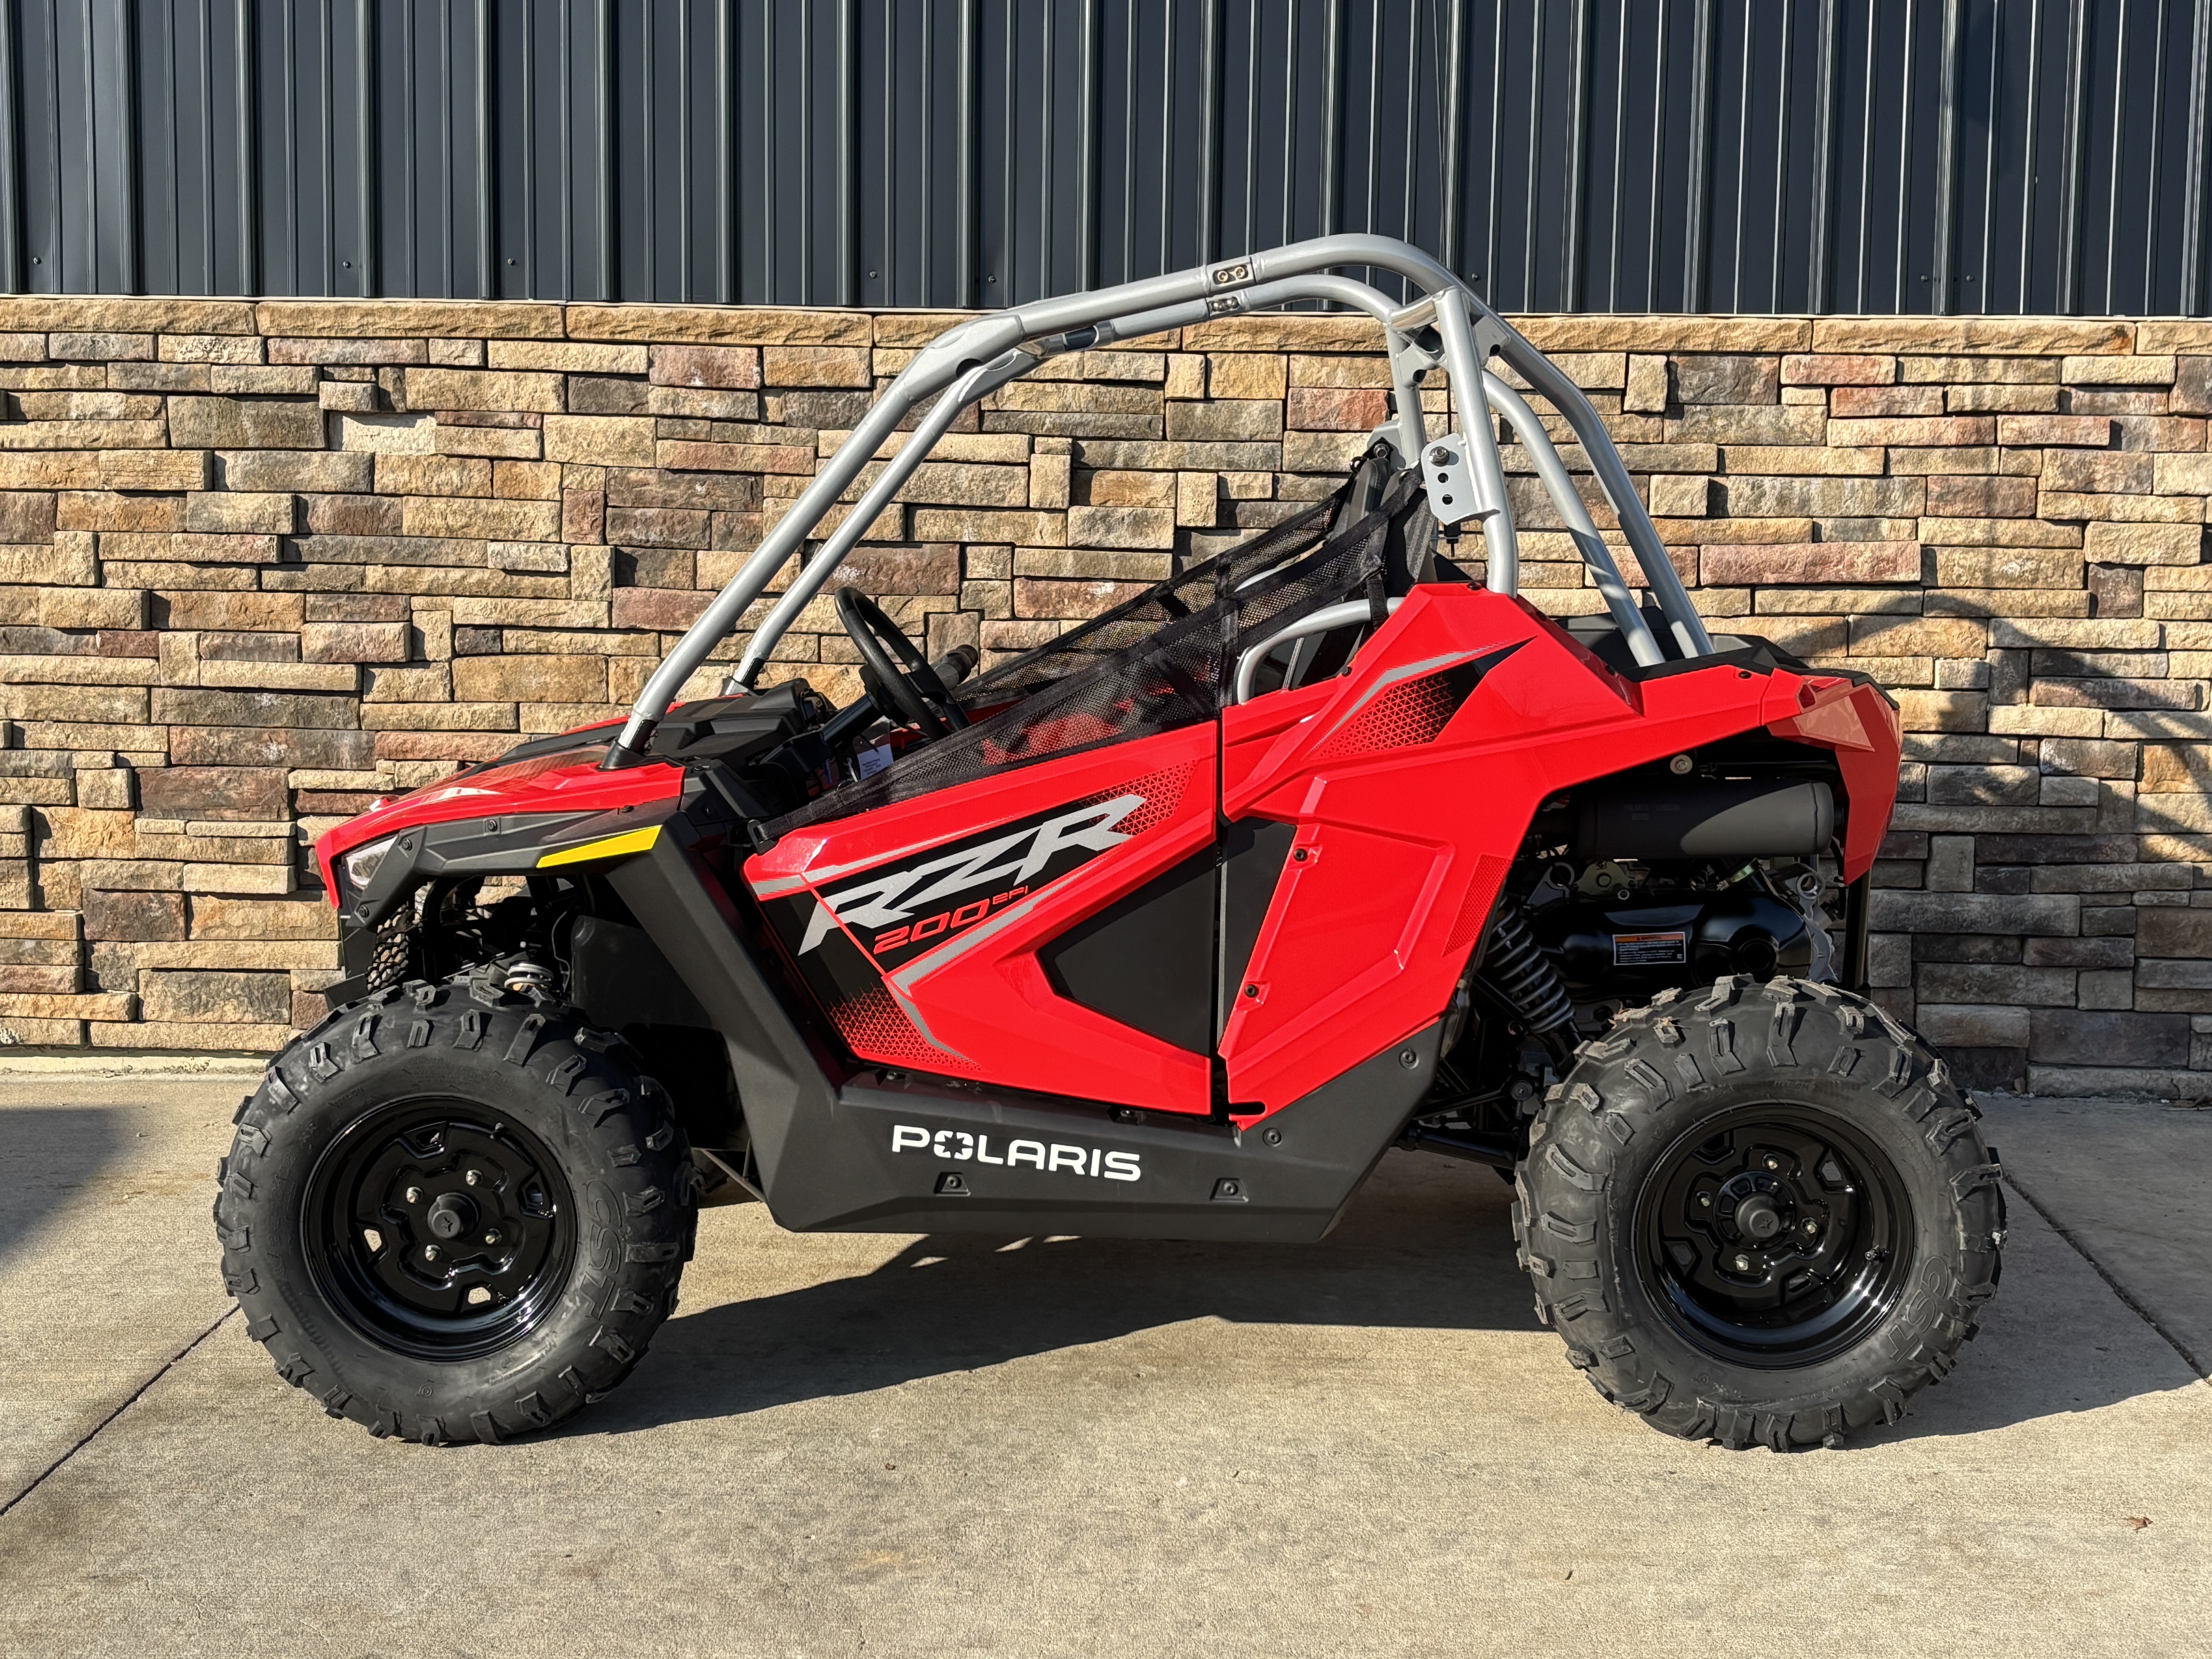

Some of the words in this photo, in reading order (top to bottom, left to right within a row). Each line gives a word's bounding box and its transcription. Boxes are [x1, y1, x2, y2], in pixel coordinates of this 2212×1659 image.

[799, 794, 1147, 955] RZR
[873, 902, 991, 955] 200
[993, 886, 1029, 904] EFI
[892, 1125, 1142, 1182] POLARIS
[579, 1179, 623, 1321] CST
[1888, 1256, 1949, 1364] CST
